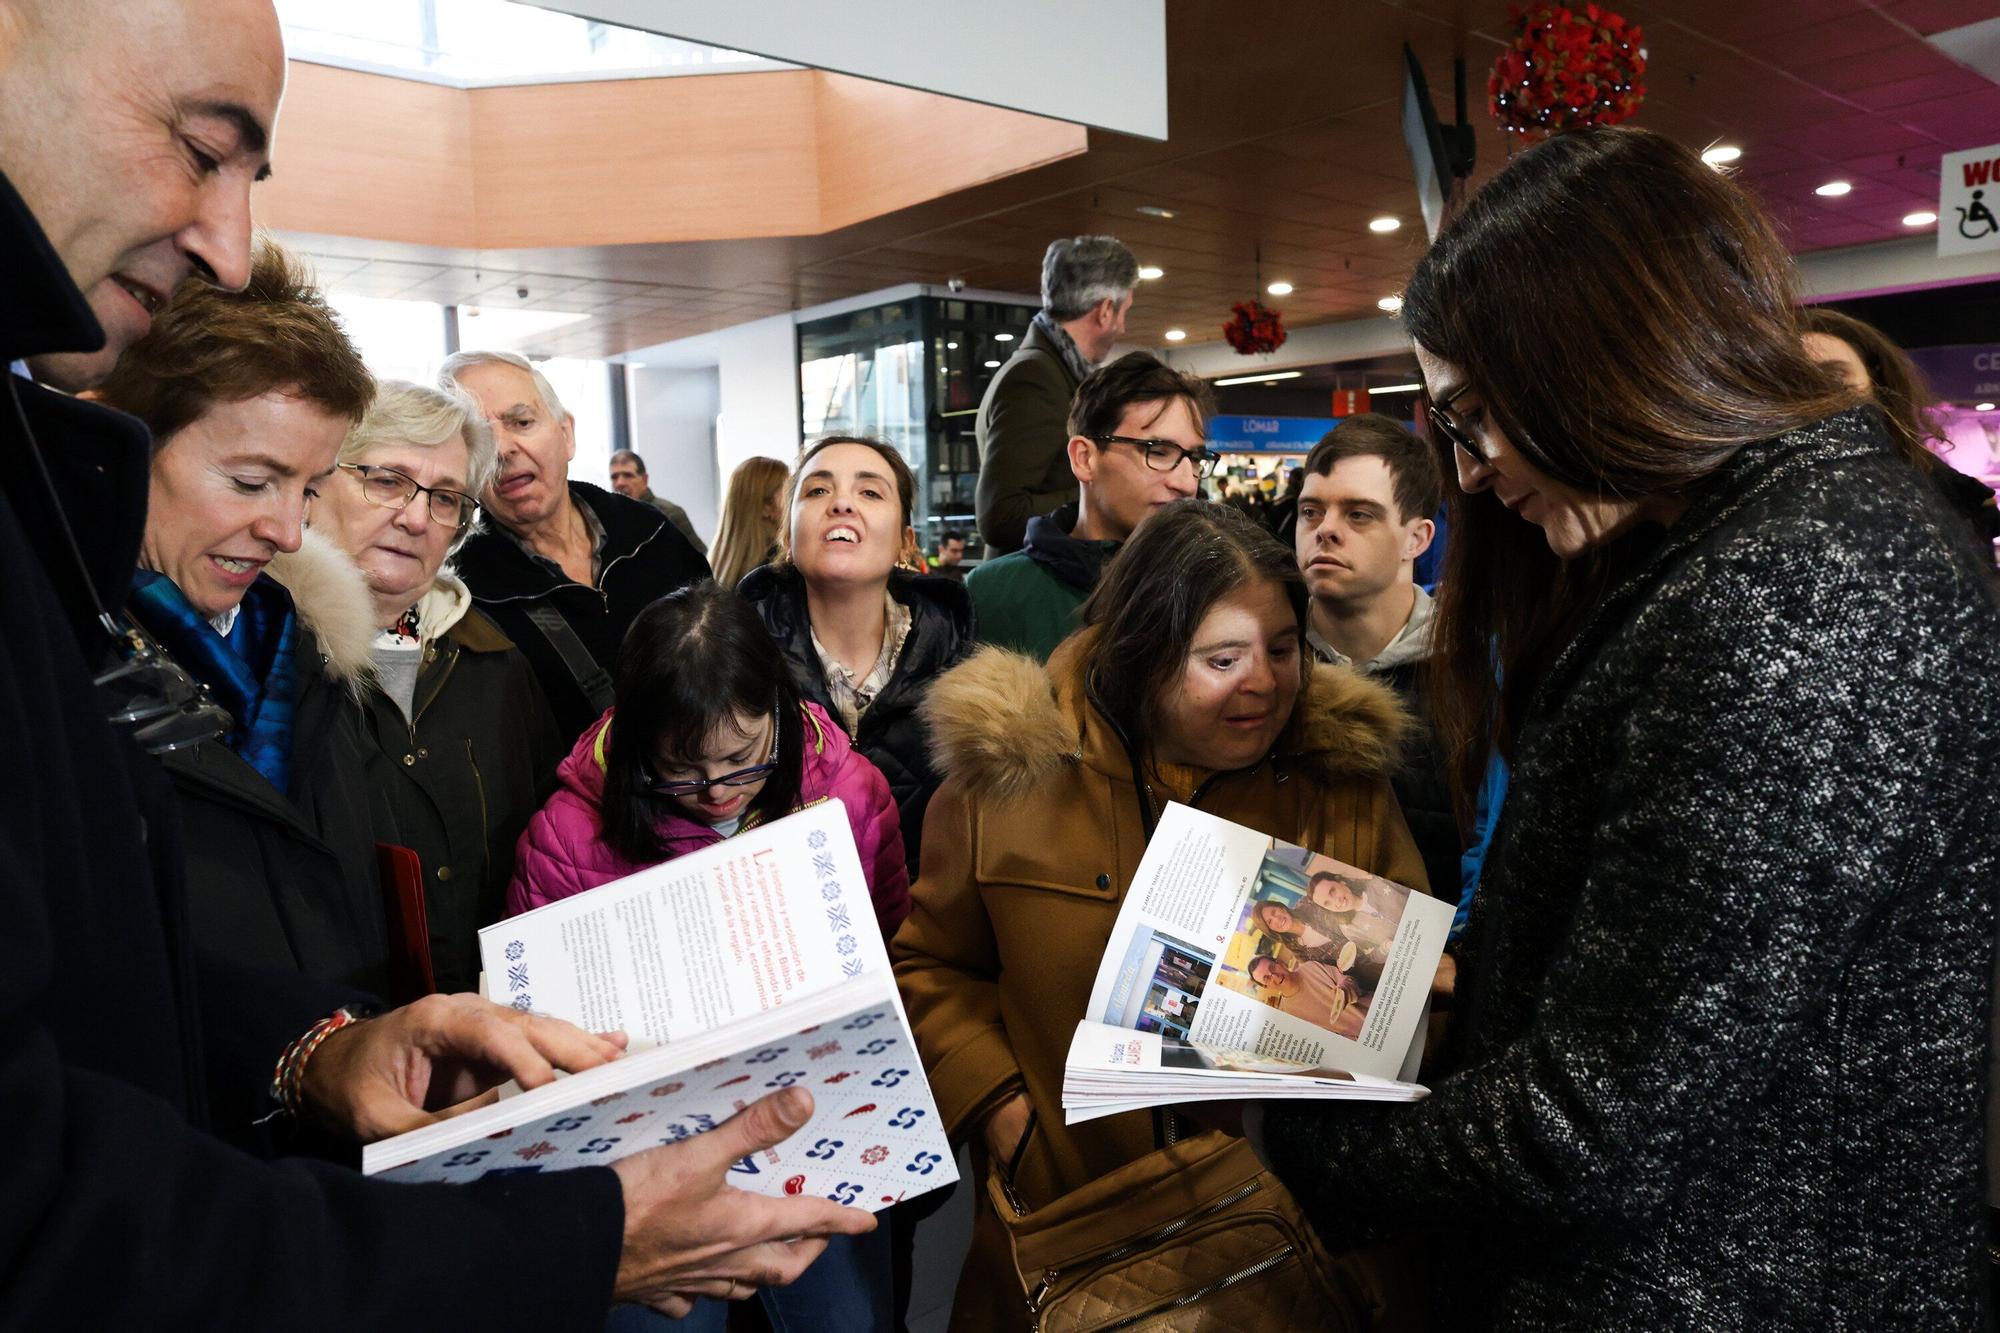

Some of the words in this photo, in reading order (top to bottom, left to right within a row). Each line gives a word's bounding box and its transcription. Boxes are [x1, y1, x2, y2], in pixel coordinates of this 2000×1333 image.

[757, 939, 780, 993] reflejando
[778, 956, 795, 990] Bilbao
[782, 916, 803, 966] evolución
[796, 968, 807, 982] de
[747, 952, 771, 1010] económica
